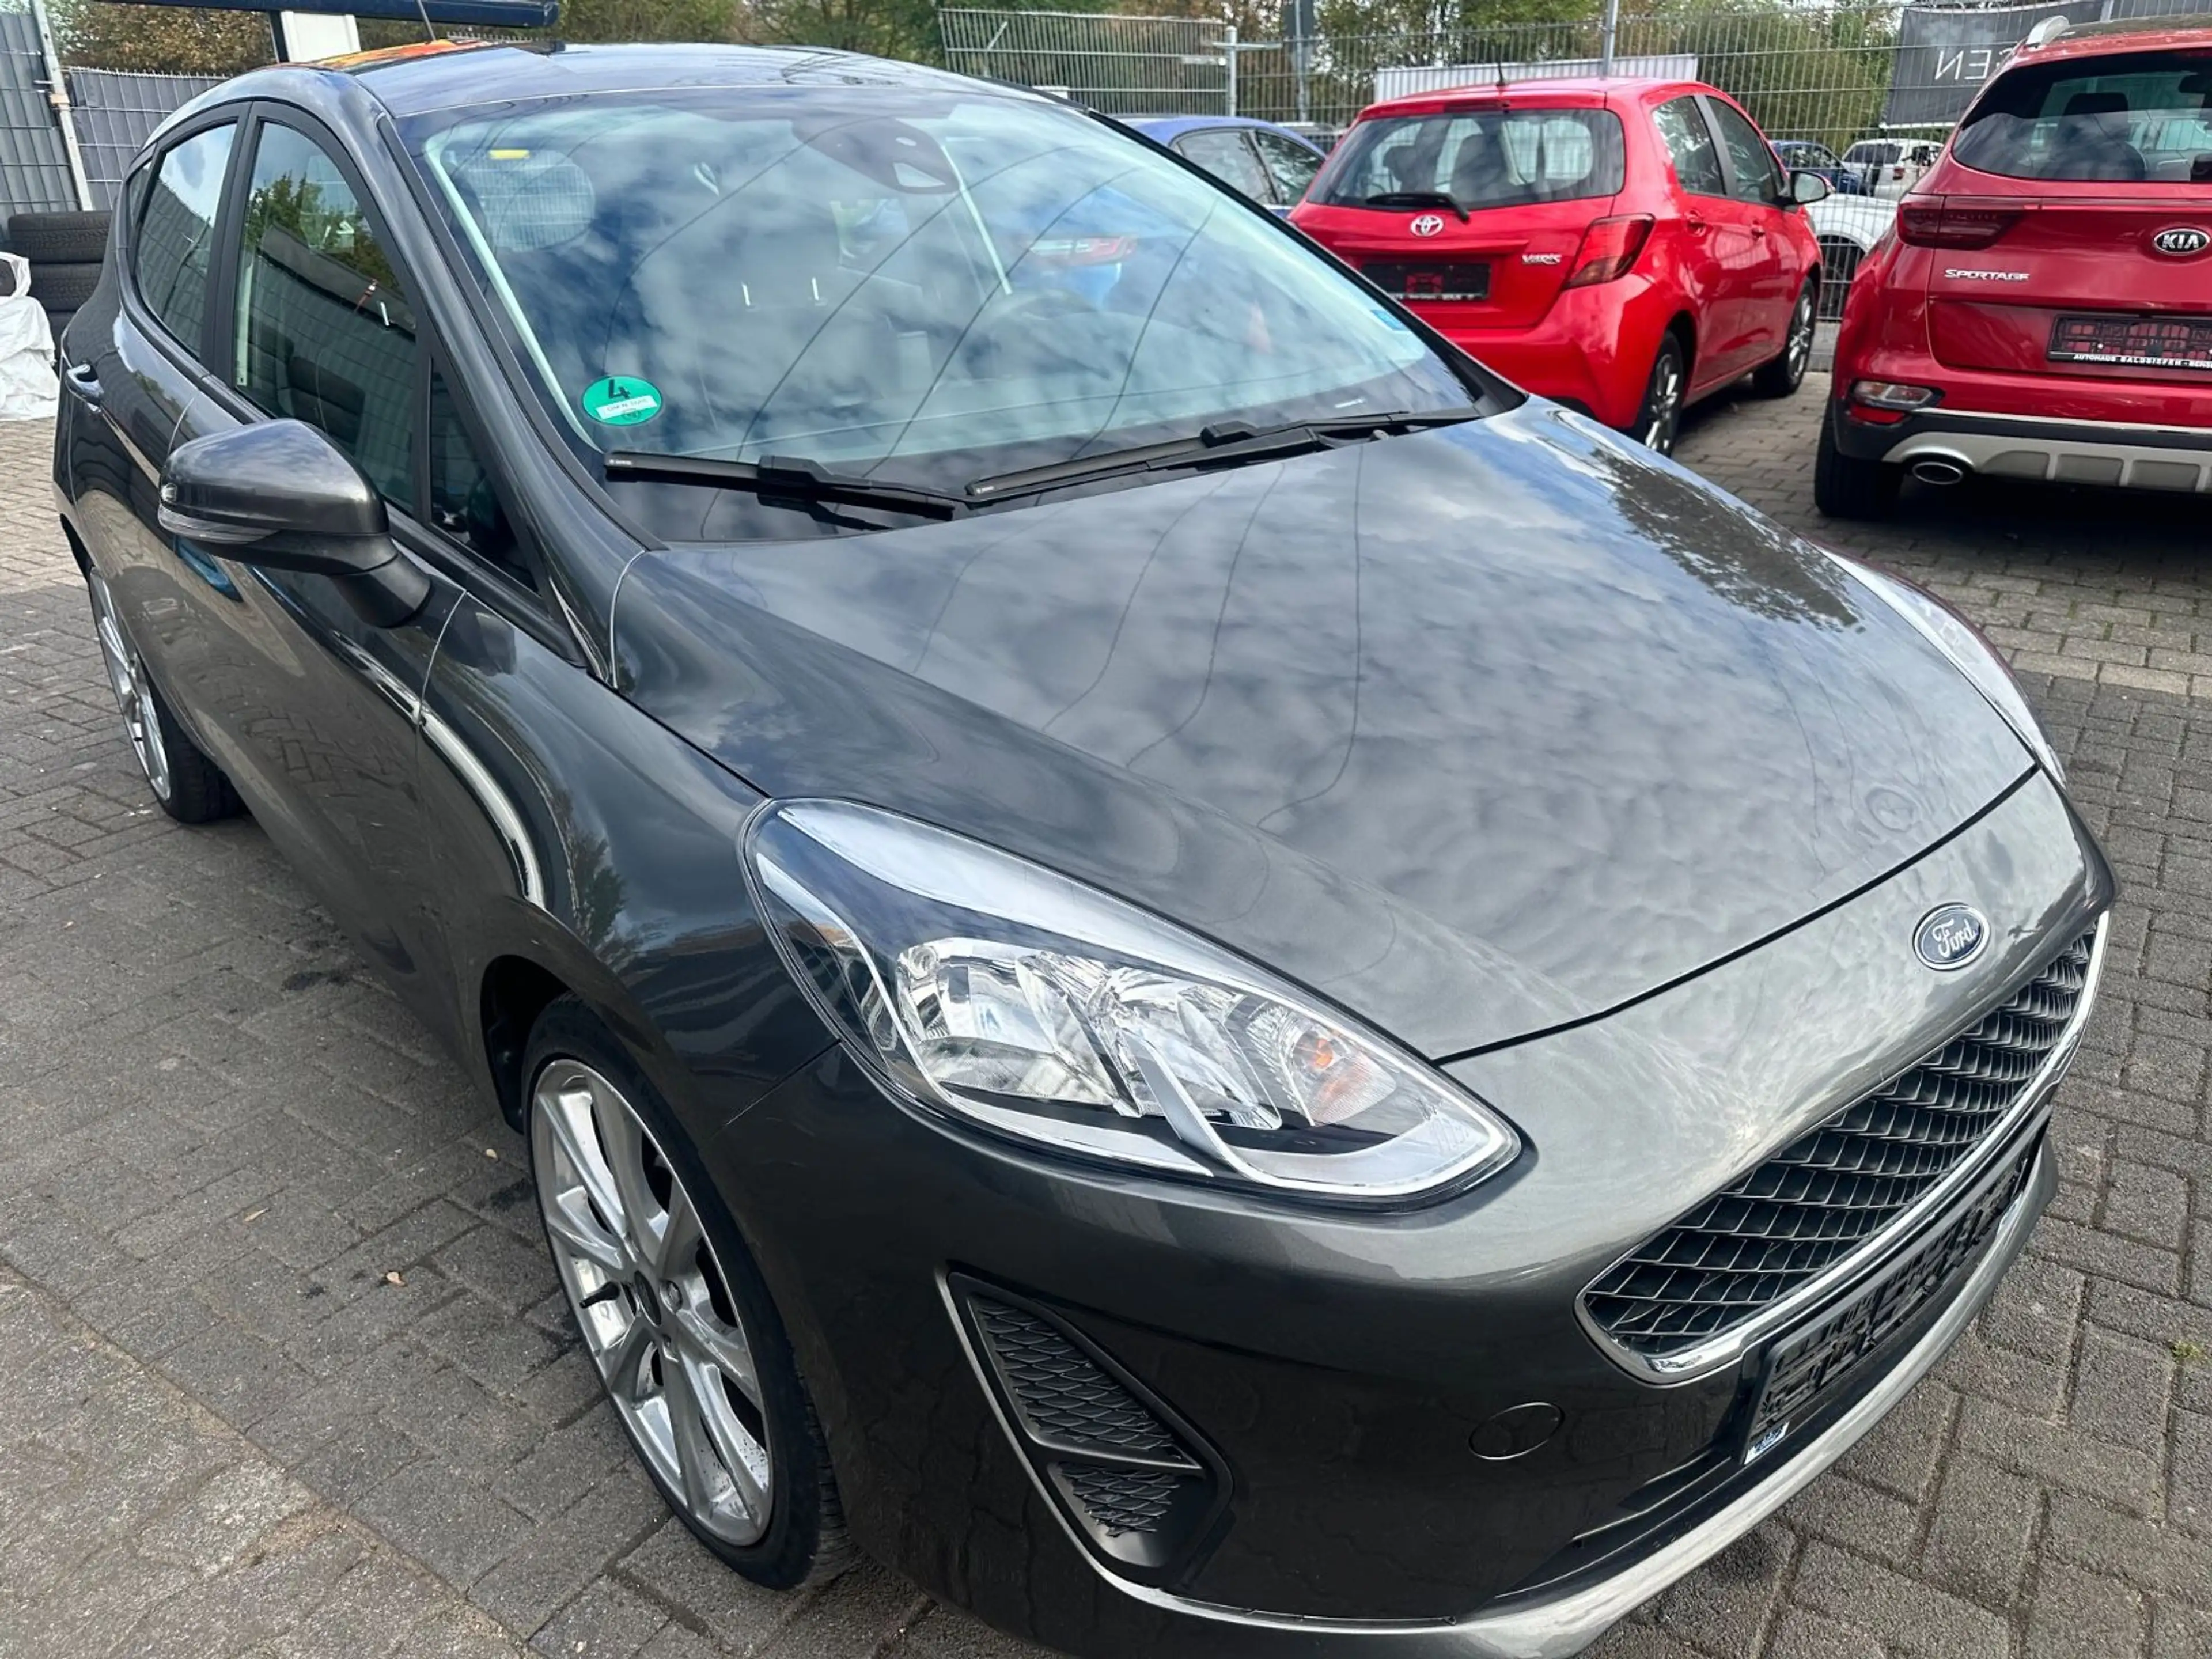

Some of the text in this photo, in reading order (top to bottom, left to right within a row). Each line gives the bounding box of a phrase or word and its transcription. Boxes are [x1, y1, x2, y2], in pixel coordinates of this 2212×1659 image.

[2162, 233, 2199, 249] KIA
[2074, 353, 2116, 363] AUTOHAUS
[608, 379, 630, 399] 4
[1932, 918, 1978, 957] Ford
